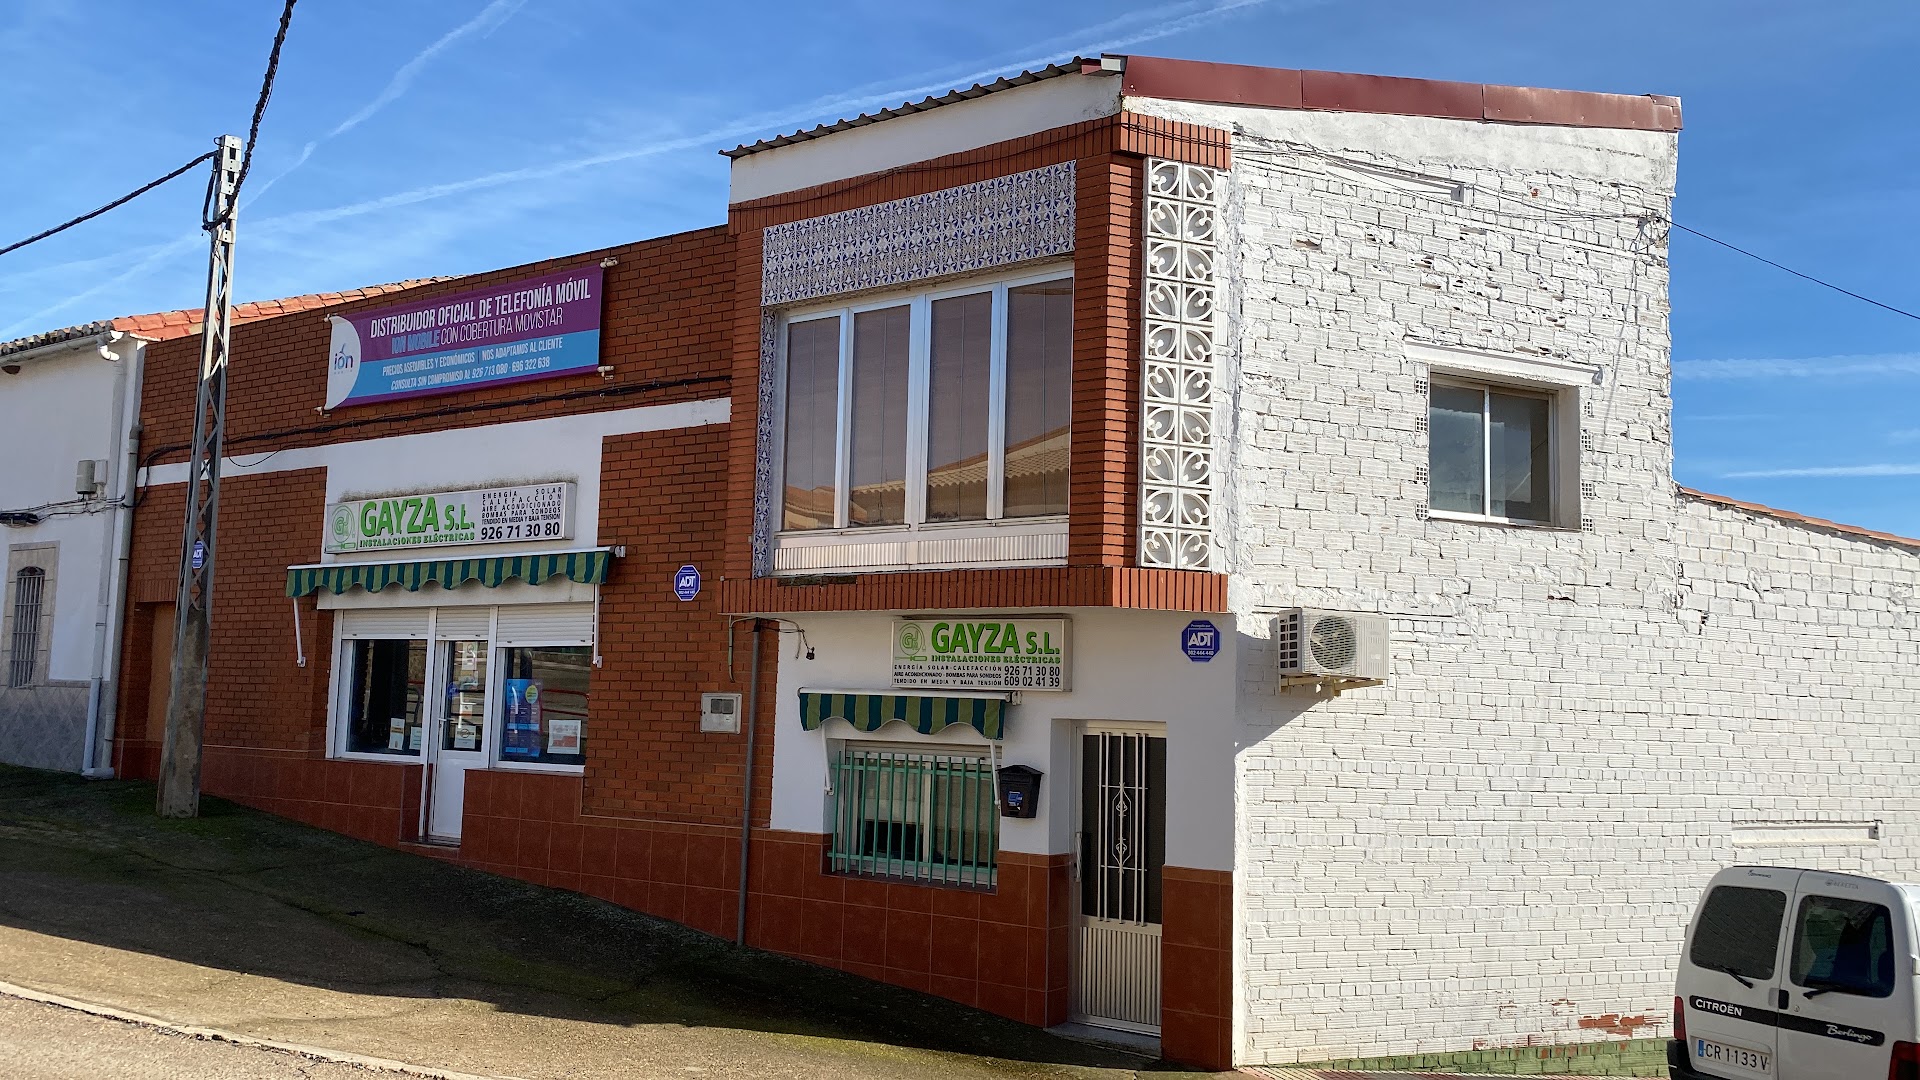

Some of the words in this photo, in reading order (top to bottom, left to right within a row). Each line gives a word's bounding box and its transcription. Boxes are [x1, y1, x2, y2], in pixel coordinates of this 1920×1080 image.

[370, 308, 436, 338] DISTRIBUIDOR
[438, 302, 476, 326] OFICIAL
[478, 298, 492, 318] DE
[495, 282, 552, 316] TELEFONÍA
[556, 277, 591, 304] MÓVIL
[407, 330, 440, 352] MOBILE
[440, 326, 459, 345] CON
[460, 316, 514, 342] COBERTURA
[516, 307, 563, 332] MOVISTAR
[482, 349, 496, 361] NOS
[495, 343, 529, 359] ADAPTAMOS
[530, 342, 537, 352] AL
[538, 337, 564, 351] CLIENTE
[382, 364, 404, 376] PRECIOS
[404, 358, 434, 373] ASEQUIBLES
[434, 358, 439, 369] Y
[440, 352, 475, 367] ECONÓMICOS
[391, 377, 417, 391] CONSULTA
[418, 376, 428, 387] SIN
[428, 370, 463, 386] COMPROMISO
[464, 370, 471, 379] AL
[472, 367, 484, 379] 926
[484, 365, 495, 377] 713
[512, 360, 524, 372] 696
[524, 358, 537, 370] 322
[537, 356, 550, 369] 638
[482, 490, 518, 499] ENERGÍA
[536, 487, 561, 495] SOLAR
[502, 500, 561, 510] ACONDICIONADO
[531, 507, 560, 515] SONDEOS
[360, 496, 439, 537] GAYZA
[444, 504, 475, 531] S.L.
[360, 536, 422, 548] INSTALACIONES
[423, 531, 475, 543] ELÉCTRICAS
[481, 526, 503, 540] 926
[507, 525, 520, 538] 71
[526, 523, 540, 537] 30
[545, 522, 560, 536] 80
[679, 576, 696, 587] ADT
[931, 622, 1020, 654] GAYZA
[1026, 632, 1060, 654] S.L.
[1188, 632, 1213, 646] ADT
[931, 655, 1001, 663] INSTALACIONES
[1003, 655, 1060, 664] ELÉCTRICAS
[1004, 666, 1020, 676] 926
[1022, 666, 1032, 676] 71
[1036, 666, 1046, 676] 30
[1049, 666, 1060, 676] 80
[1004, 676, 1020, 686] 609
[1022, 676, 1032, 686] 02
[1036, 677, 1046, 686] 41
[1049, 677, 1060, 687] 39
[1696, 999, 1743, 1016] CITROËN
[1826, 1024, 1873, 1042] Berlingo
[1706, 1043, 1721, 1060] CR
[1726, 1048, 1757, 1068] 1133
[1761, 1055, 1768, 1070] V
